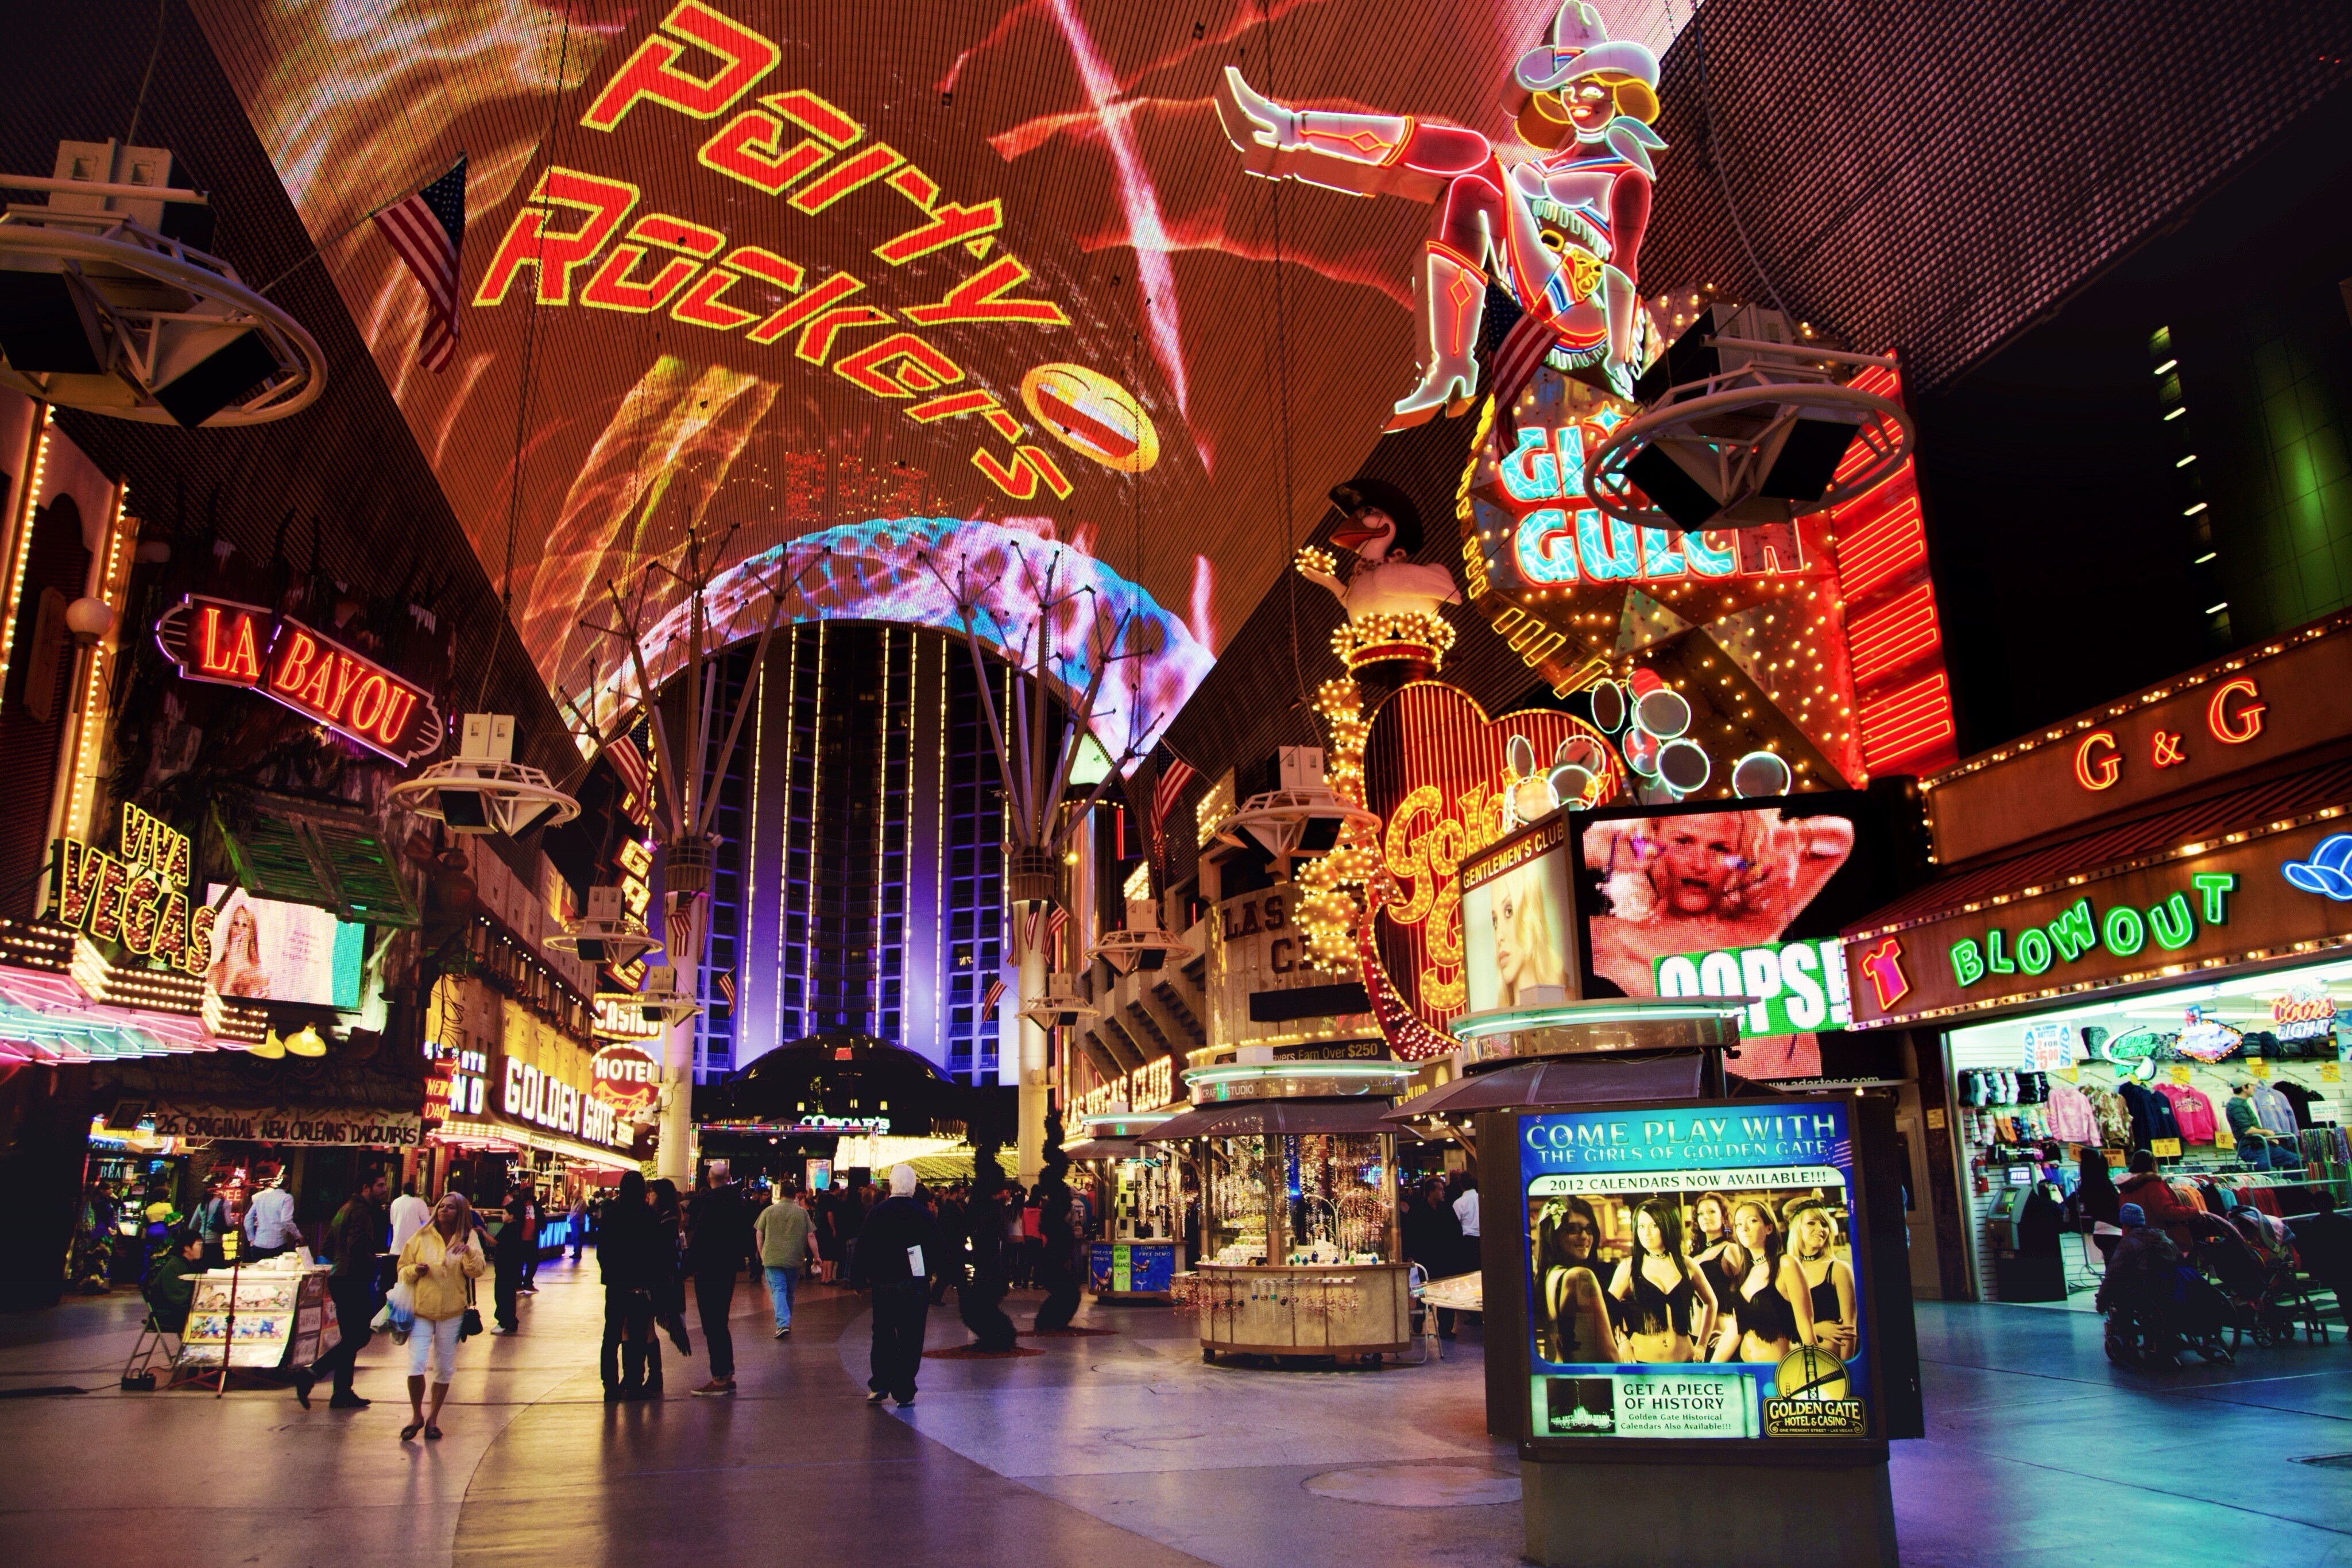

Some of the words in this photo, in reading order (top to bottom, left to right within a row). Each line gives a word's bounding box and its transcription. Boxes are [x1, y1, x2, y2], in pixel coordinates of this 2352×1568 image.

[203, 608, 260, 677] LA
[276, 632, 416, 744] BAYOU
[2075, 730, 2123, 792] G
[2152, 731, 2188, 769] &
[2207, 678, 2269, 745] G
[121, 802, 190, 886] VIVA
[1463, 842, 1533, 890] GENTLEMEN'S
[1534, 824, 1565, 852] CLUB
[60, 837, 218, 977] VEGAS
[1223, 895, 1286, 942] LAS
[1949, 873, 2239, 988] BLOWOUT
[1658, 940, 1848, 1033] OOPS!
[2269, 993, 2336, 1024] Coors
[2037, 1040, 2042, 1050] 2
[2117, 1035, 2153, 1049] BUD
[2276, 1019, 2334, 1042] LIGHT
[1298, 1049, 1320, 1060] Earn
[1322, 1047, 1345, 1059] Over
[1348, 1043, 1378, 1058] $250
[2110, 1045, 2157, 1059] LIGHT
[1132, 1055, 1173, 1113] CLUB
[1227, 1085, 1254, 1096] STUDIO
[504, 1055, 579, 1136] GOLDEN
[582, 1093, 616, 1147] GATE
[156, 1113, 179, 1136] 26
[185, 1114, 256, 1139] ORIGINAL
[261, 1119, 287, 1140] NEW
[289, 1120, 347, 1143] ORLEANS
[350, 1123, 419, 1145] DAIQUIRIS
[1526, 1121, 1630, 1149] COME
[1643, 1117, 1729, 1146] PLAY
[1740, 1113, 1837, 1141] WITH
[1538, 1149, 1576, 1164] THE
[1584, 1147, 1642, 1163] GIRLS
[1649, 1145, 1676, 1160] OF
[1683, 1142, 1767, 1159] GOLDEN
[1775, 1140, 1828, 1156] GATE
[1550, 1179, 1584, 1191] 2012
[1590, 1176, 1680, 1190] CALENDARS
[1686, 1175, 1721, 1187] NOW
[1727, 1172, 1827, 1186] AVAILABLE!!!
[1623, 1384, 1655, 1395] GET
[1661, 1384, 1671, 1395] A
[1677, 1384, 1724, 1395] PIECE
[1624, 1397, 1646, 1409] OF
[1652, 1397, 1724, 1410] HISTORY
[1769, 1402, 1823, 1419] GOLDEN
[1825, 1402, 1860, 1420] GATE
[1785, 1416, 1811, 1426] HOTEL
[1811, 1417, 1817, 1426] &
[1817, 1415, 1847, 1426] CASINO
